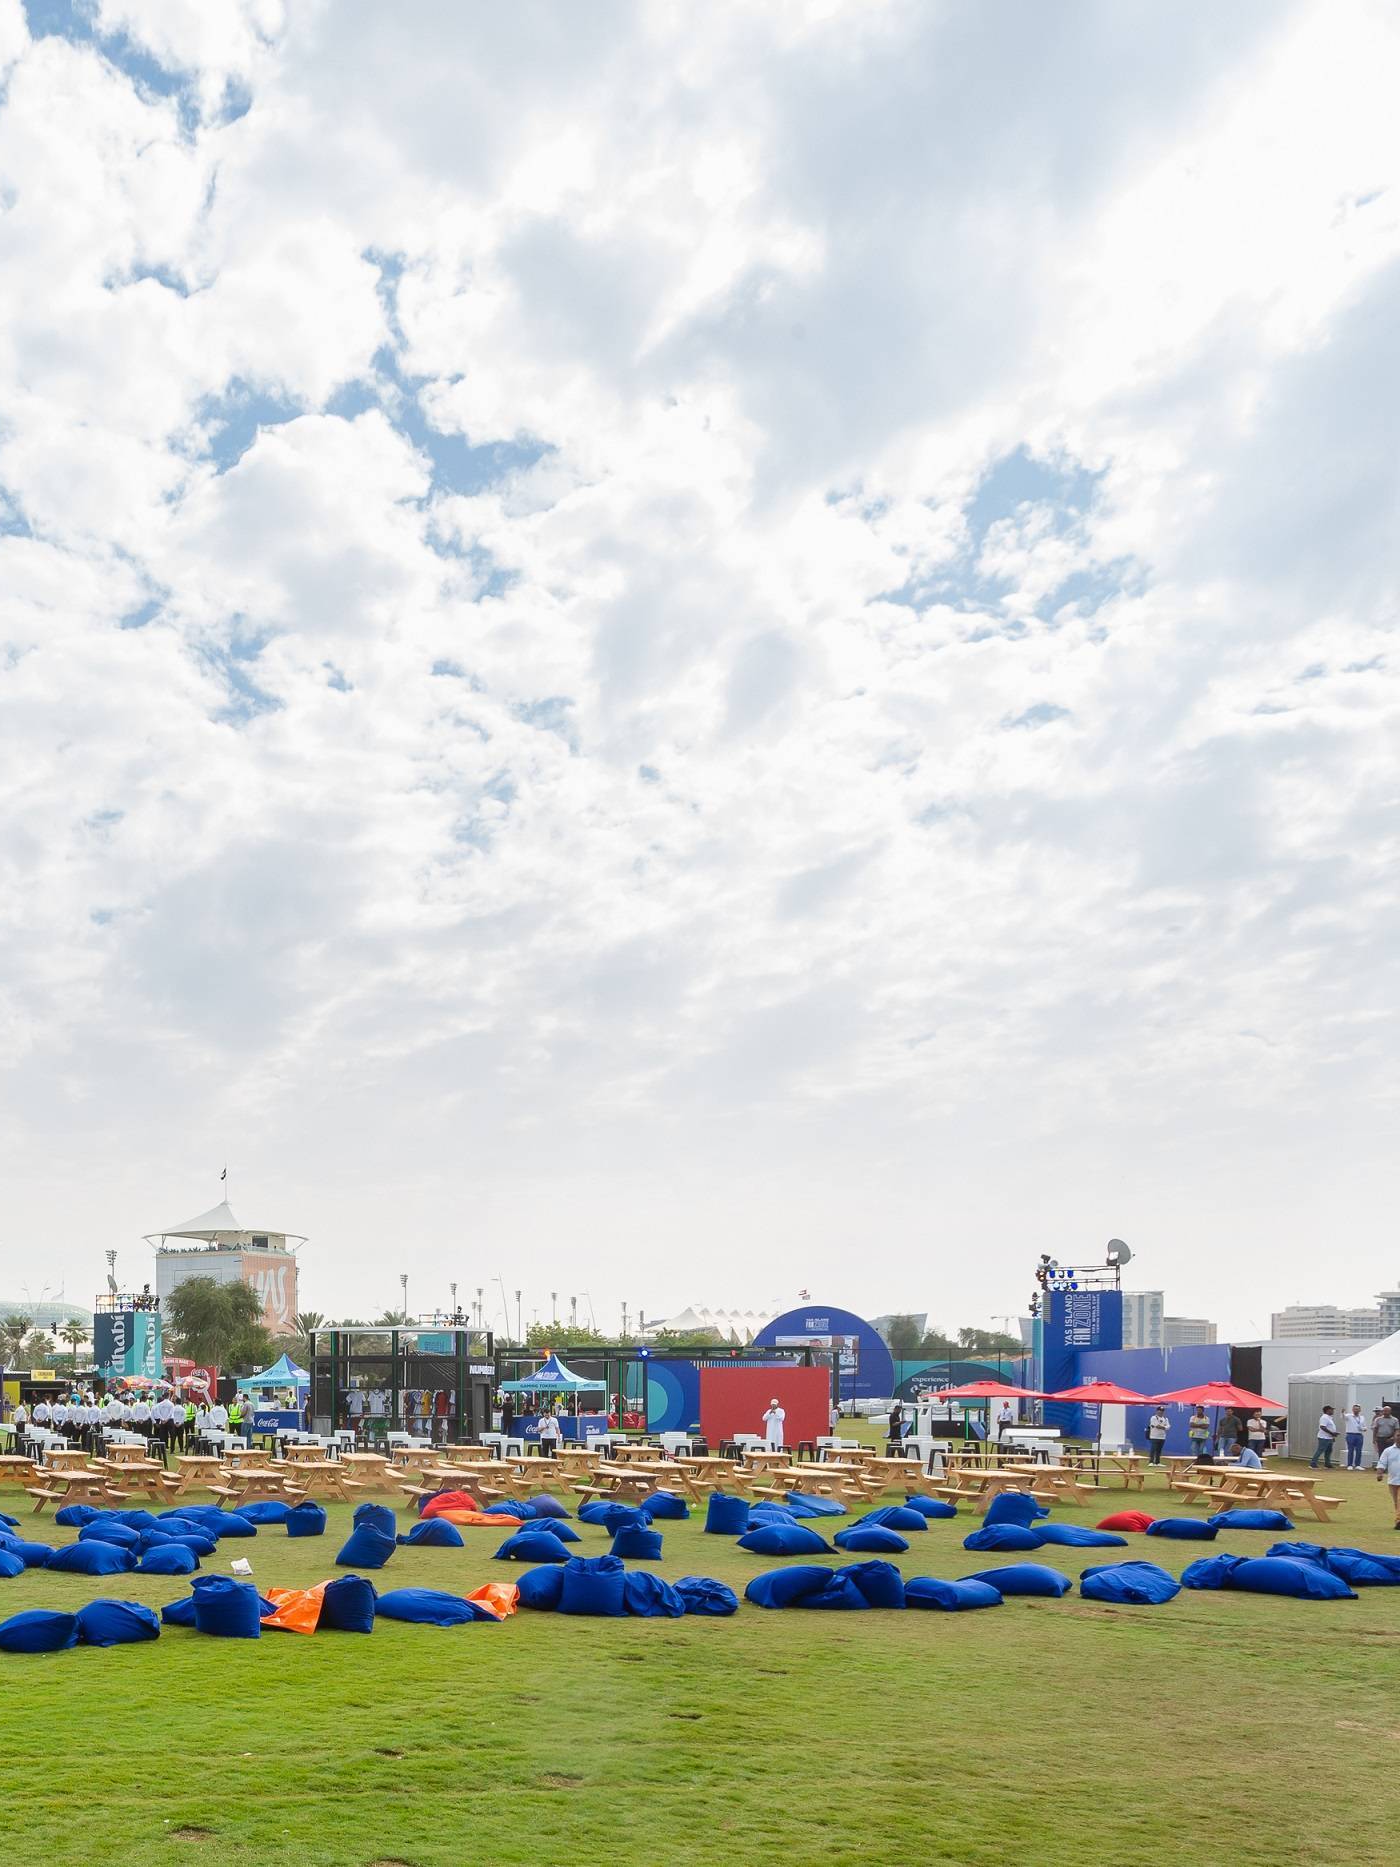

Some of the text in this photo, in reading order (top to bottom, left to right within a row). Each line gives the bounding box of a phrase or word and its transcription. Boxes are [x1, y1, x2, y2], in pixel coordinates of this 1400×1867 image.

[1064, 1294, 1073, 1346] YAS ISLAND
[1073, 1294, 1091, 1345] FAN ZONE
[257, 1419, 280, 1428] Coca-Cola
